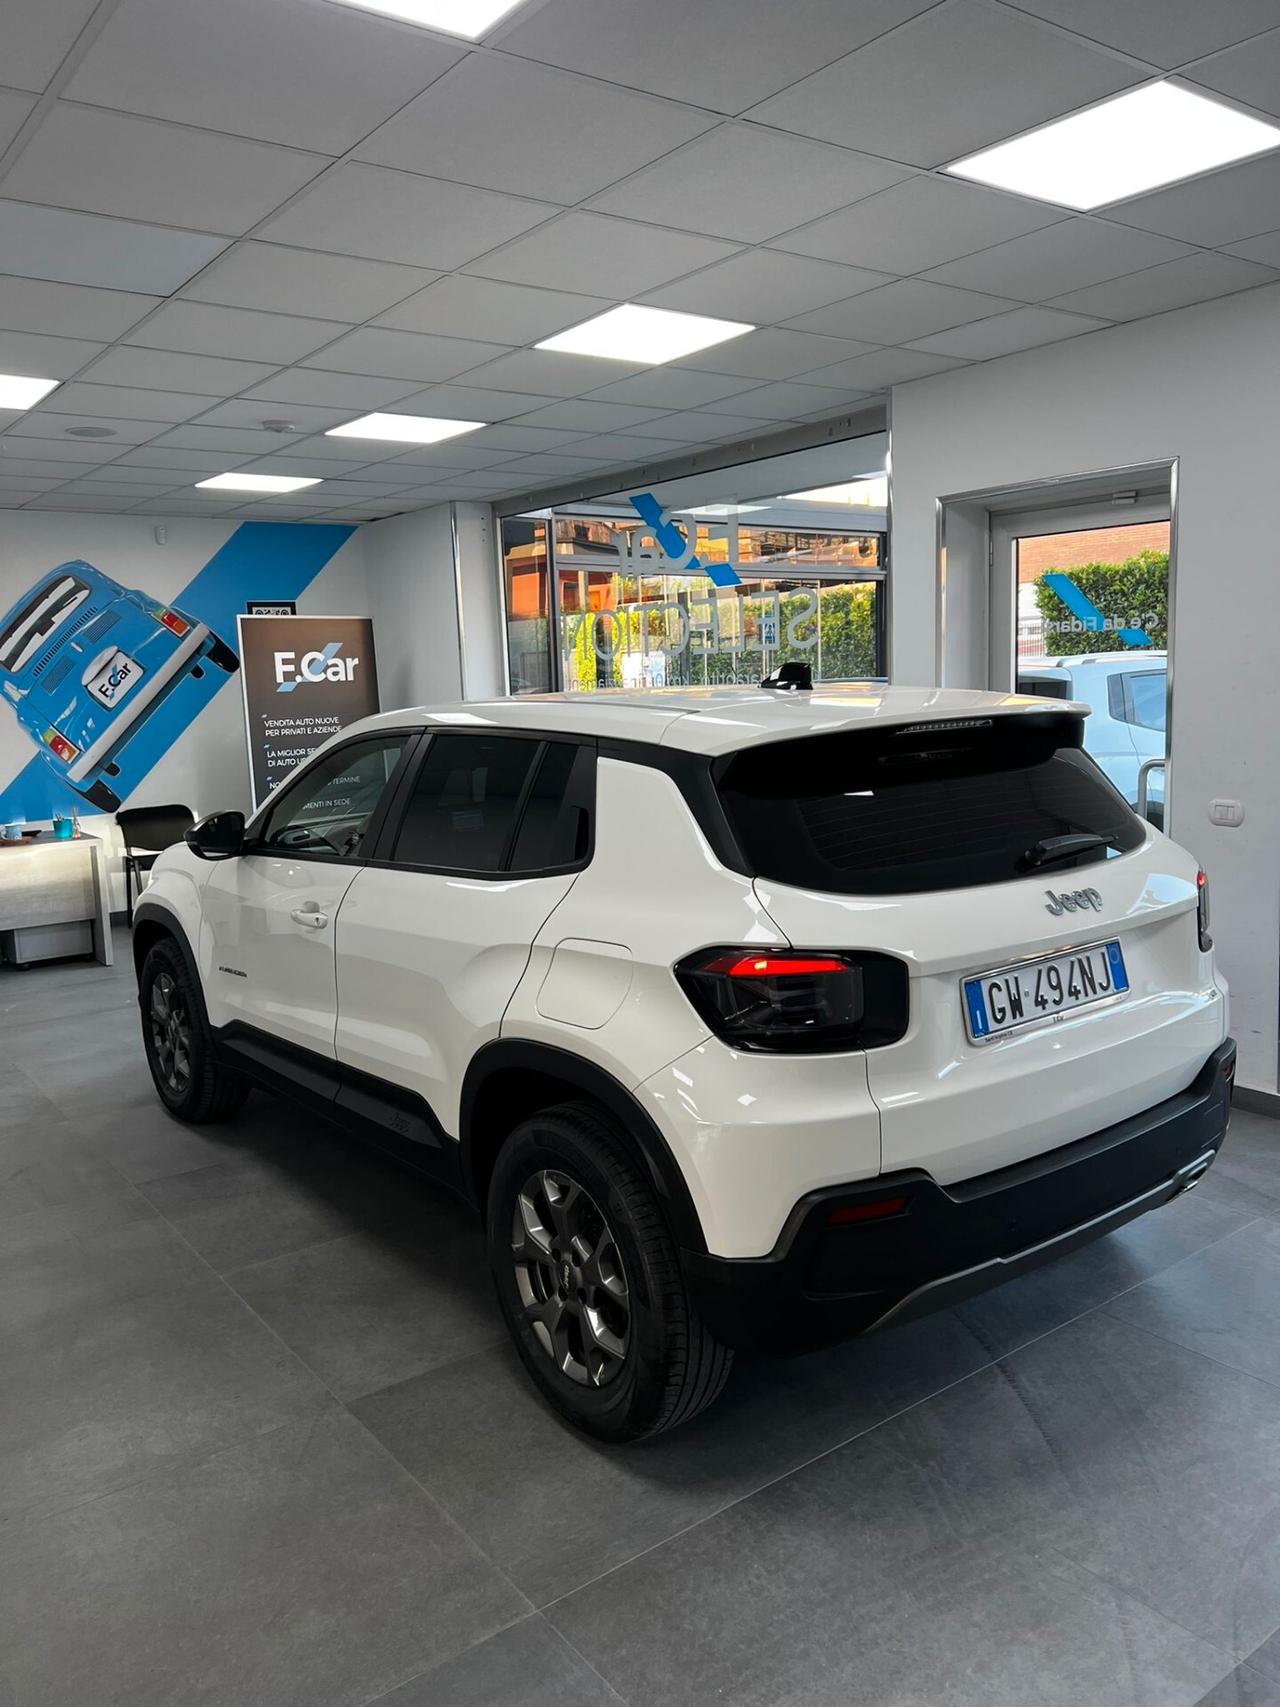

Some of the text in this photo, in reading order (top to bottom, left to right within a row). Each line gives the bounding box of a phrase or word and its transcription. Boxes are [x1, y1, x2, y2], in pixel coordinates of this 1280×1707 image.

[274, 651, 359, 683] F.Car
[98, 662, 131, 698] F.Car
[263, 716, 340, 727] VENDITA AUTO NUOVE
[265, 725, 342, 737] PER PRIVATI E AZIENDE
[276, 758, 296, 767] AUTO
[277, 748, 306, 757] MIGLIOR
[1044, 886, 1104, 916] Jeep
[988, 951, 1111, 1025] GW 494NJ
